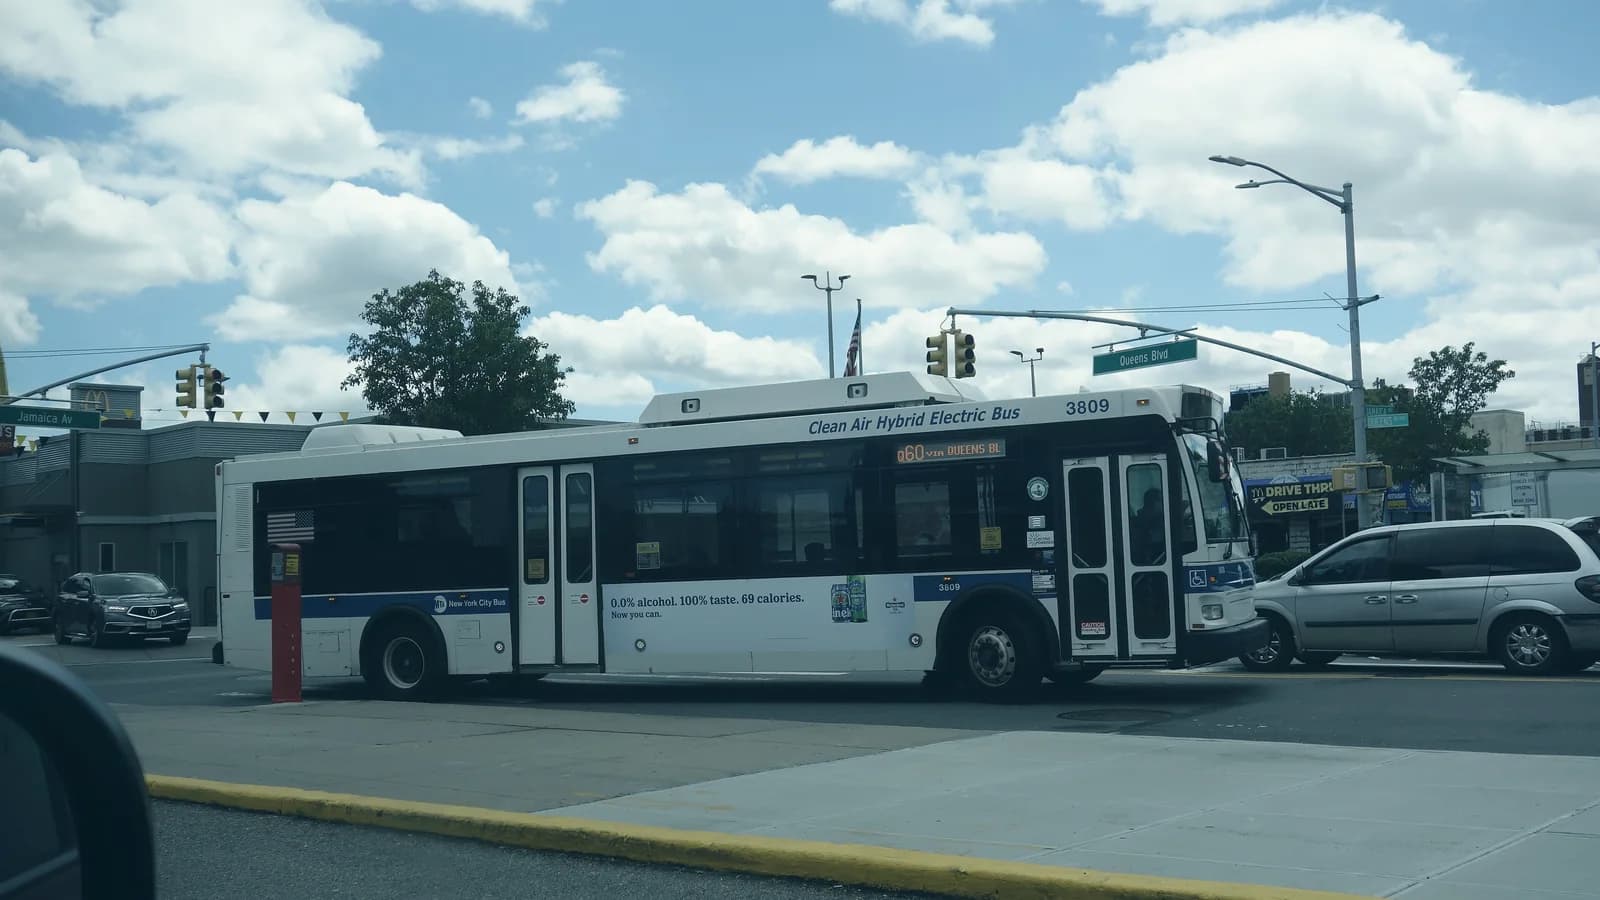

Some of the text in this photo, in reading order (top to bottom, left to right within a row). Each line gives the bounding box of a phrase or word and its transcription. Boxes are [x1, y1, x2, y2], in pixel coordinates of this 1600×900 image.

[1119, 348, 1169, 367] Queens Blvd
[1065, 398, 1110, 416] 3809
[17, 410, 73, 424] Jamaica Av
[808, 406, 1020, 435] Clean Air Hybrid Electric Bus
[896, 443, 925, 462] Q60
[947, 443, 985, 456] QUEENS
[988, 442, 1001, 454] BL
[1265, 484, 1302, 497] DRIVE
[1273, 499, 1326, 511] OPEN LATE
[938, 583, 961, 592] 3809
[448, 598, 506, 608] New York City Bus
[611, 592, 805, 608] 0.0% alcohol. 100% taste. 69 calories.
[611, 610, 662, 620] Now you can.
